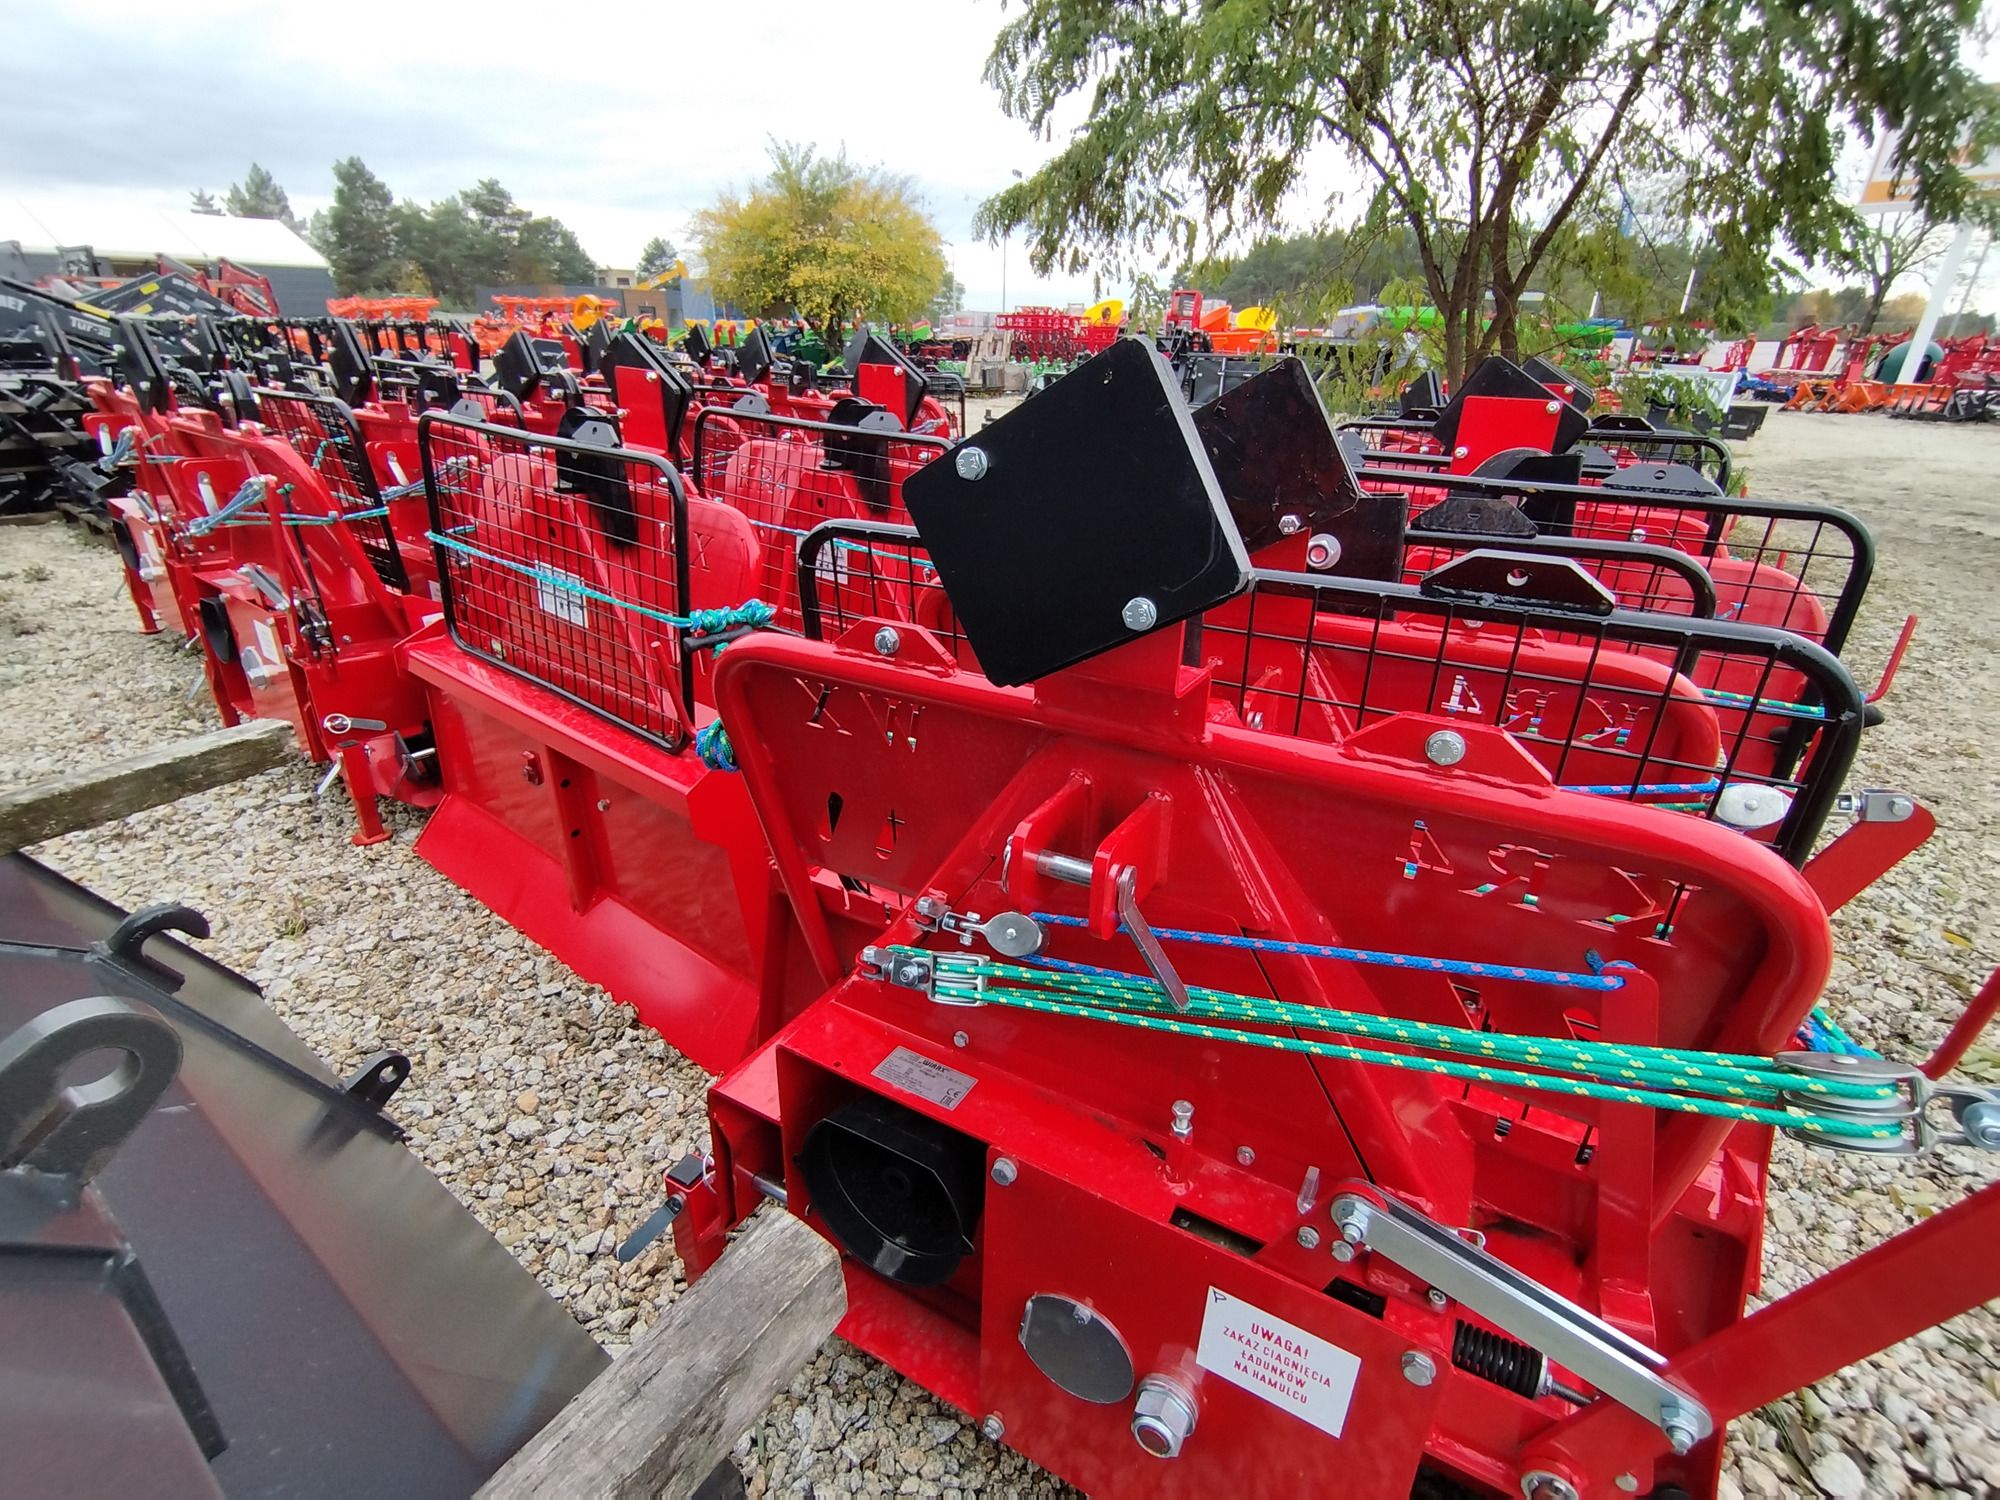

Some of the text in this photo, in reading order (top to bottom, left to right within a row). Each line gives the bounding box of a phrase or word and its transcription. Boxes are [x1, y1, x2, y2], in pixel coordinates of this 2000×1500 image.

[1223, 1326, 1260, 1352] ZAKAZ
[1251, 1322, 1309, 1360] UWAGA!
[1233, 1360, 1308, 1404] NA HAMULCU
[1241, 1349, 1307, 1389] ŁADUNKÓW
